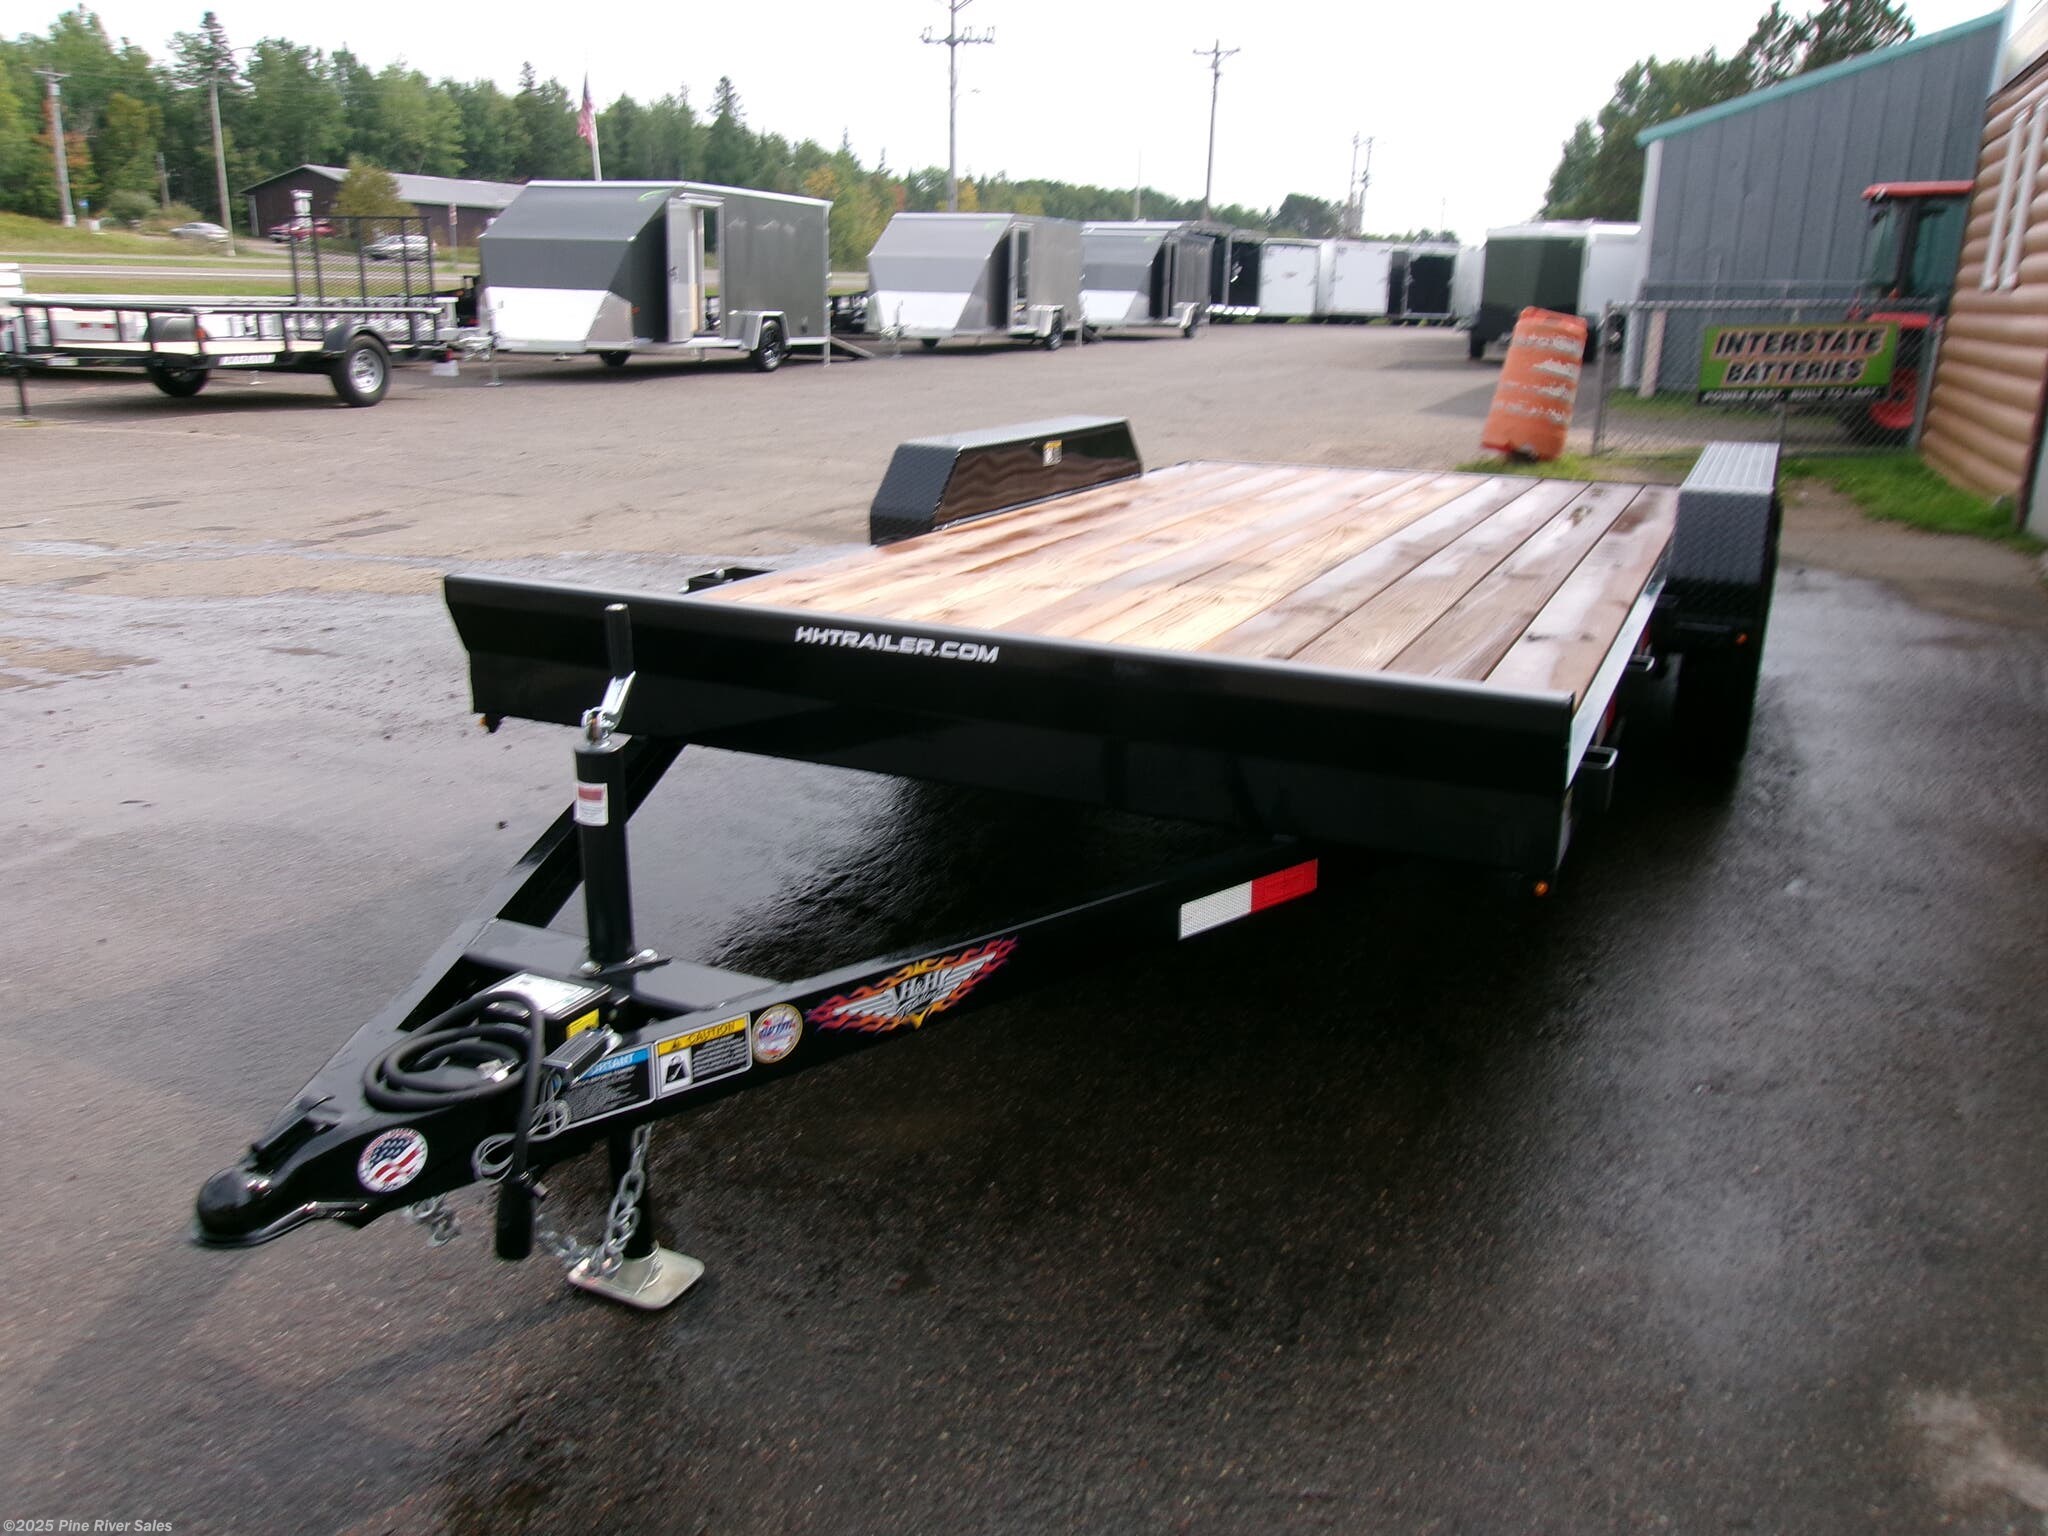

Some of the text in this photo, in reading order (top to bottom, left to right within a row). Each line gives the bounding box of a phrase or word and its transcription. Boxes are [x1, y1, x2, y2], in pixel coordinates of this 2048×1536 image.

[1715, 329, 1883, 354] INTERSTATE
[1725, 359, 1862, 383] BATTERIES
[794, 625, 1000, 664] HHTRAILER.COM
[687, 1020, 736, 1045] CAUTION
